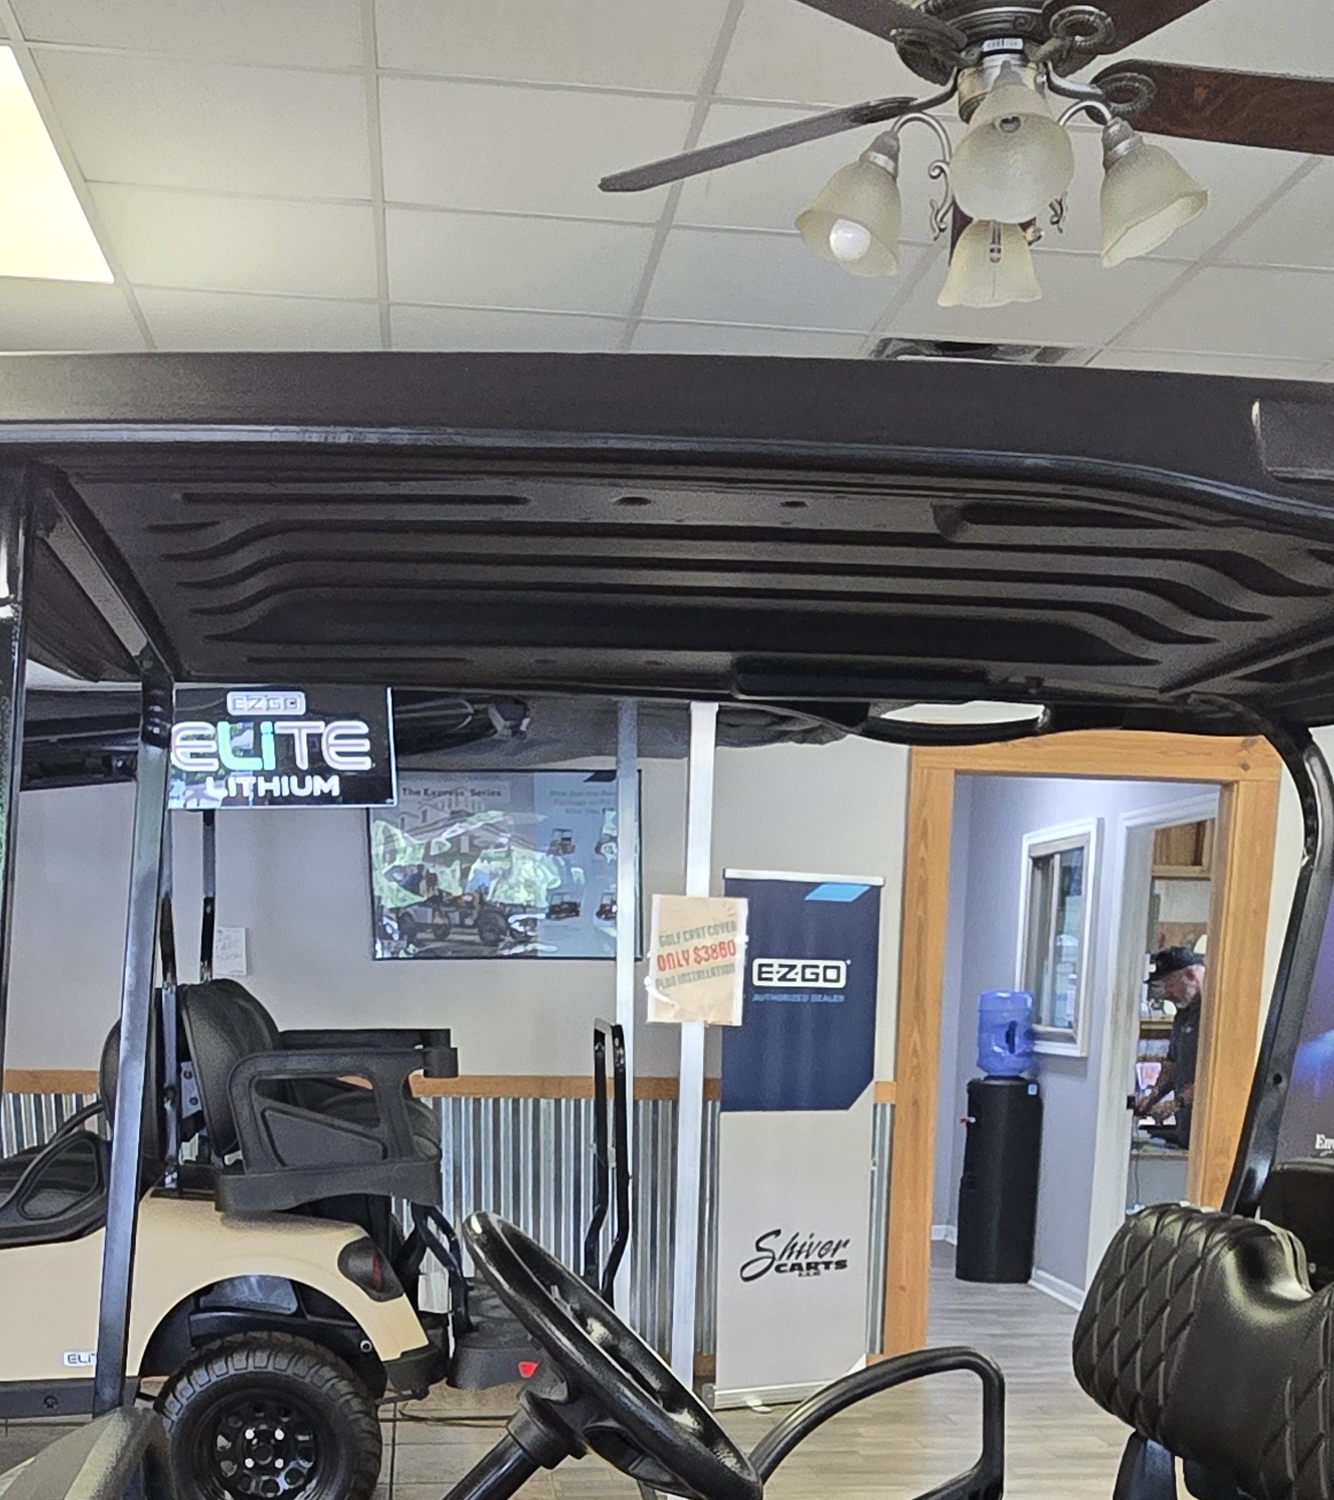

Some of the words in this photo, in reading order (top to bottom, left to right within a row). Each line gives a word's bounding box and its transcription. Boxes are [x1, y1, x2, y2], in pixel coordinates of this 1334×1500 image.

[206, 774, 341, 798] LITHIUM
[657, 949, 690, 972] ONLY
[693, 939, 737, 966] $3860
[739, 1228, 851, 1283] Shiver
[774, 1258, 848, 1274] CARTS
